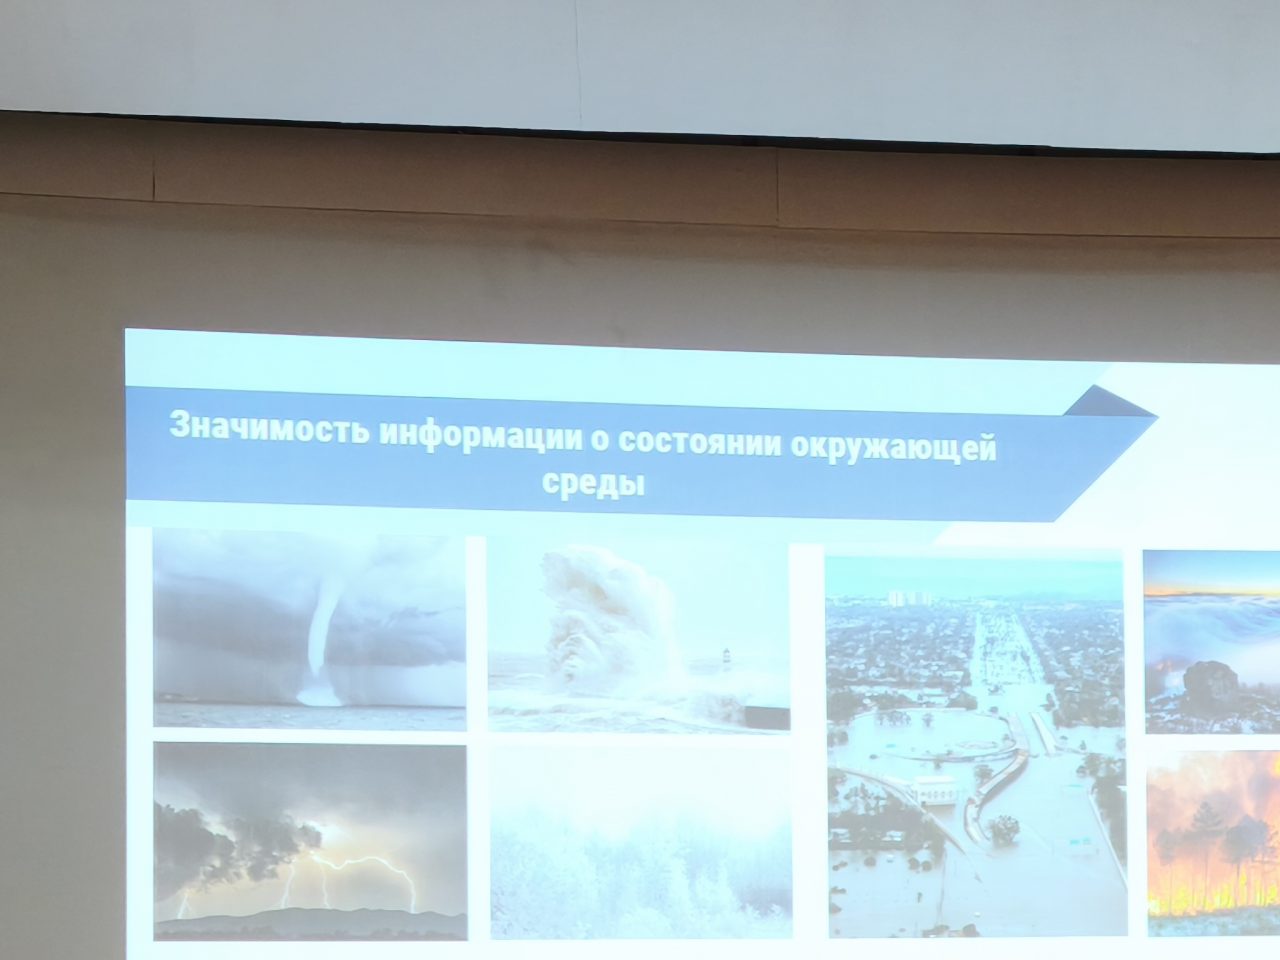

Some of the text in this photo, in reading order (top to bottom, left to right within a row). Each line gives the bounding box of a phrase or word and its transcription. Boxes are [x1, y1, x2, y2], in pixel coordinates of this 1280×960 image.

[168, 408, 997, 466] Значимость информации о состоянии окружающей
[541, 471, 645, 501] среды
